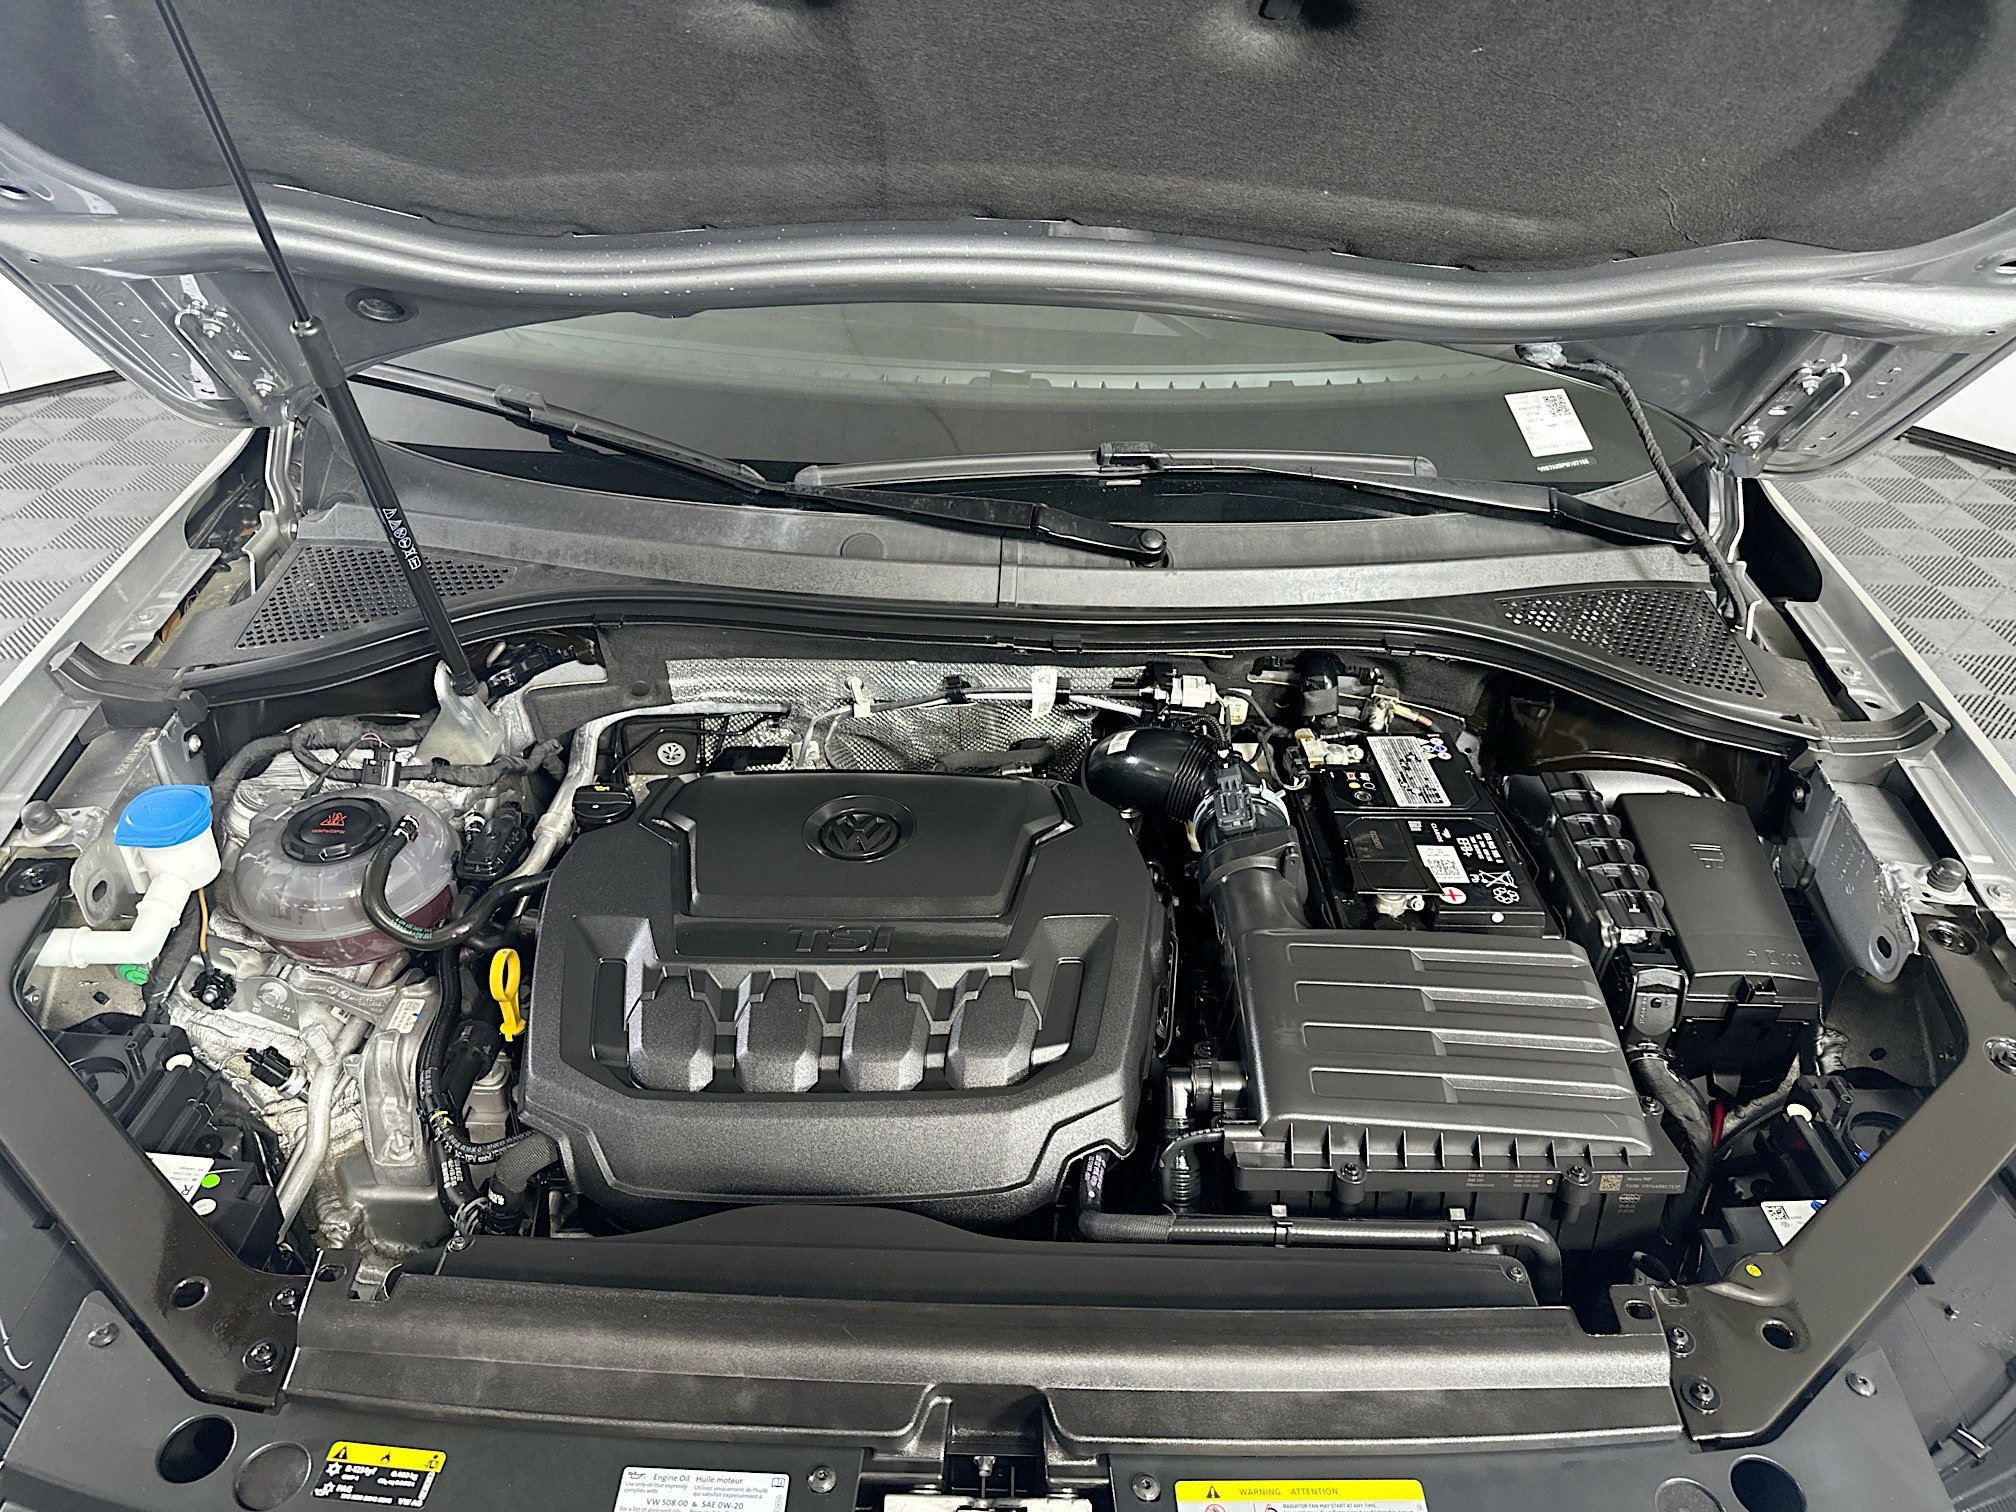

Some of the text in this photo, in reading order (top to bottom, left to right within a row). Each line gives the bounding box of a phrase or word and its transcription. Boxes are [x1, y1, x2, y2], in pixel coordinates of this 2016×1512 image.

[789, 925, 895, 953] TSI
[181, 1184, 194, 1196] R
[653, 1473, 691, 1483] Engine Oil
[695, 1475, 714, 1484] Huile
[1238, 1488, 1339, 1496] WARNING ATTENTION
[646, 1498, 660, 1506] VW
[662, 1498, 676, 1506] 508
[701, 1500, 716, 1508] SAE
[718, 1501, 744, 1510] 0W-20
